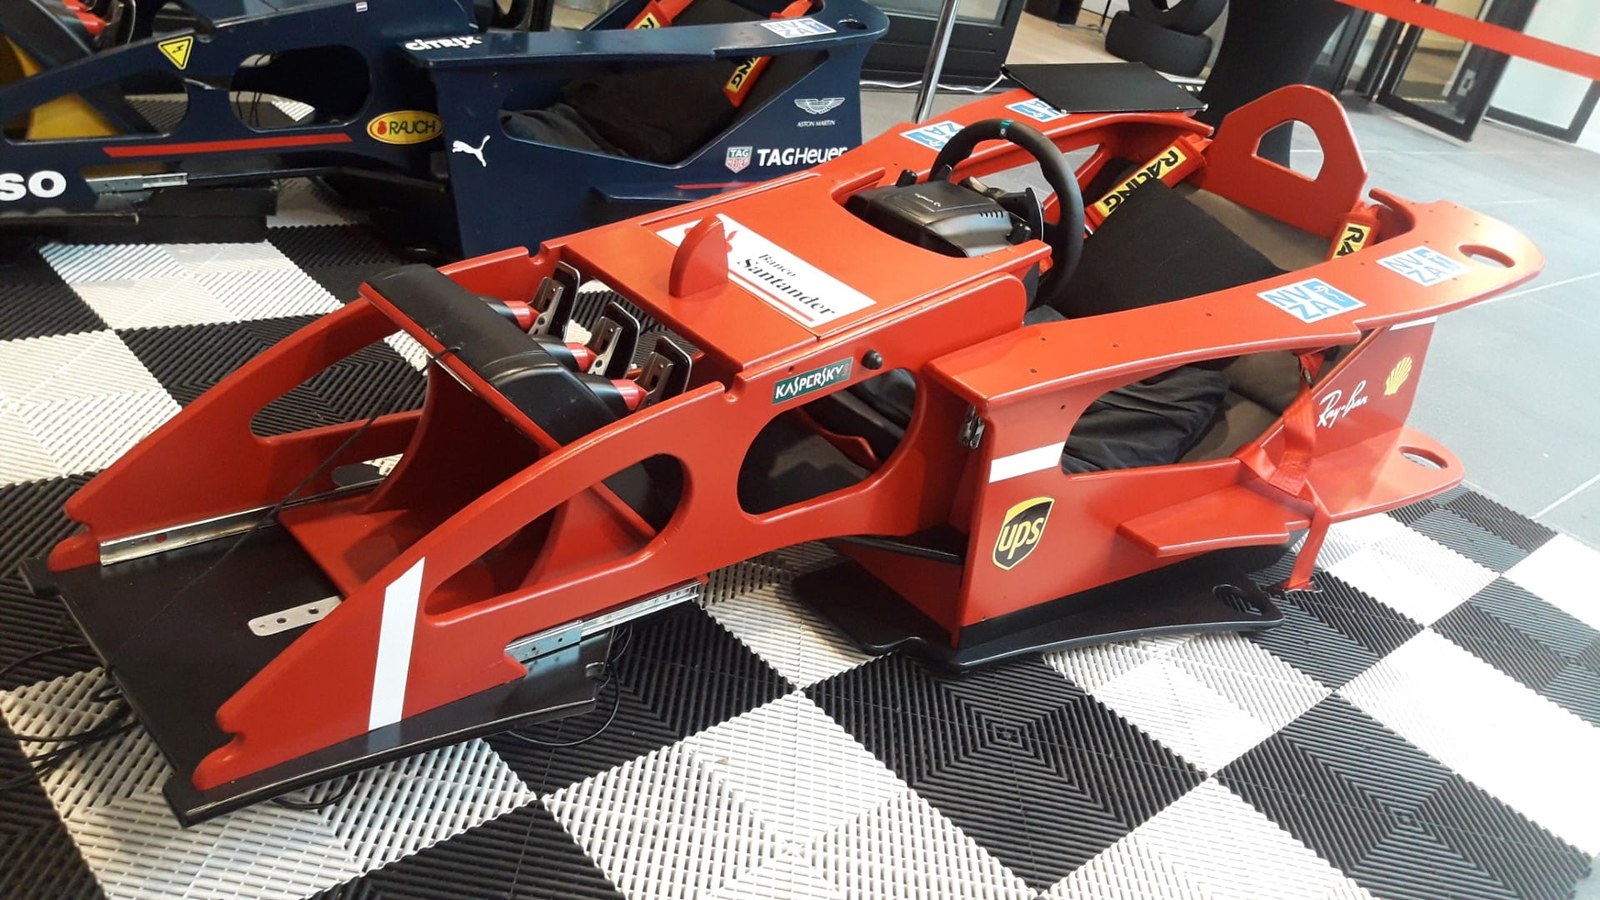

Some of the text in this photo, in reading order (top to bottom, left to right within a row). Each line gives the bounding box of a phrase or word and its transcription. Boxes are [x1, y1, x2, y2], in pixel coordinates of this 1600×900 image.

[388, 120, 436, 135] RAUCH
[796, 119, 836, 128] ASTON MARTIN
[730, 149, 750, 158] TAG
[1103, 149, 1179, 213] RACING
[758, 253, 796, 277] Banco
[736, 258, 836, 315] Santander
[1265, 286, 1311, 307] NV
[1287, 300, 1339, 321] ZA
[775, 364, 844, 400] KASPERSKY
[998, 517, 1045, 560] ups
